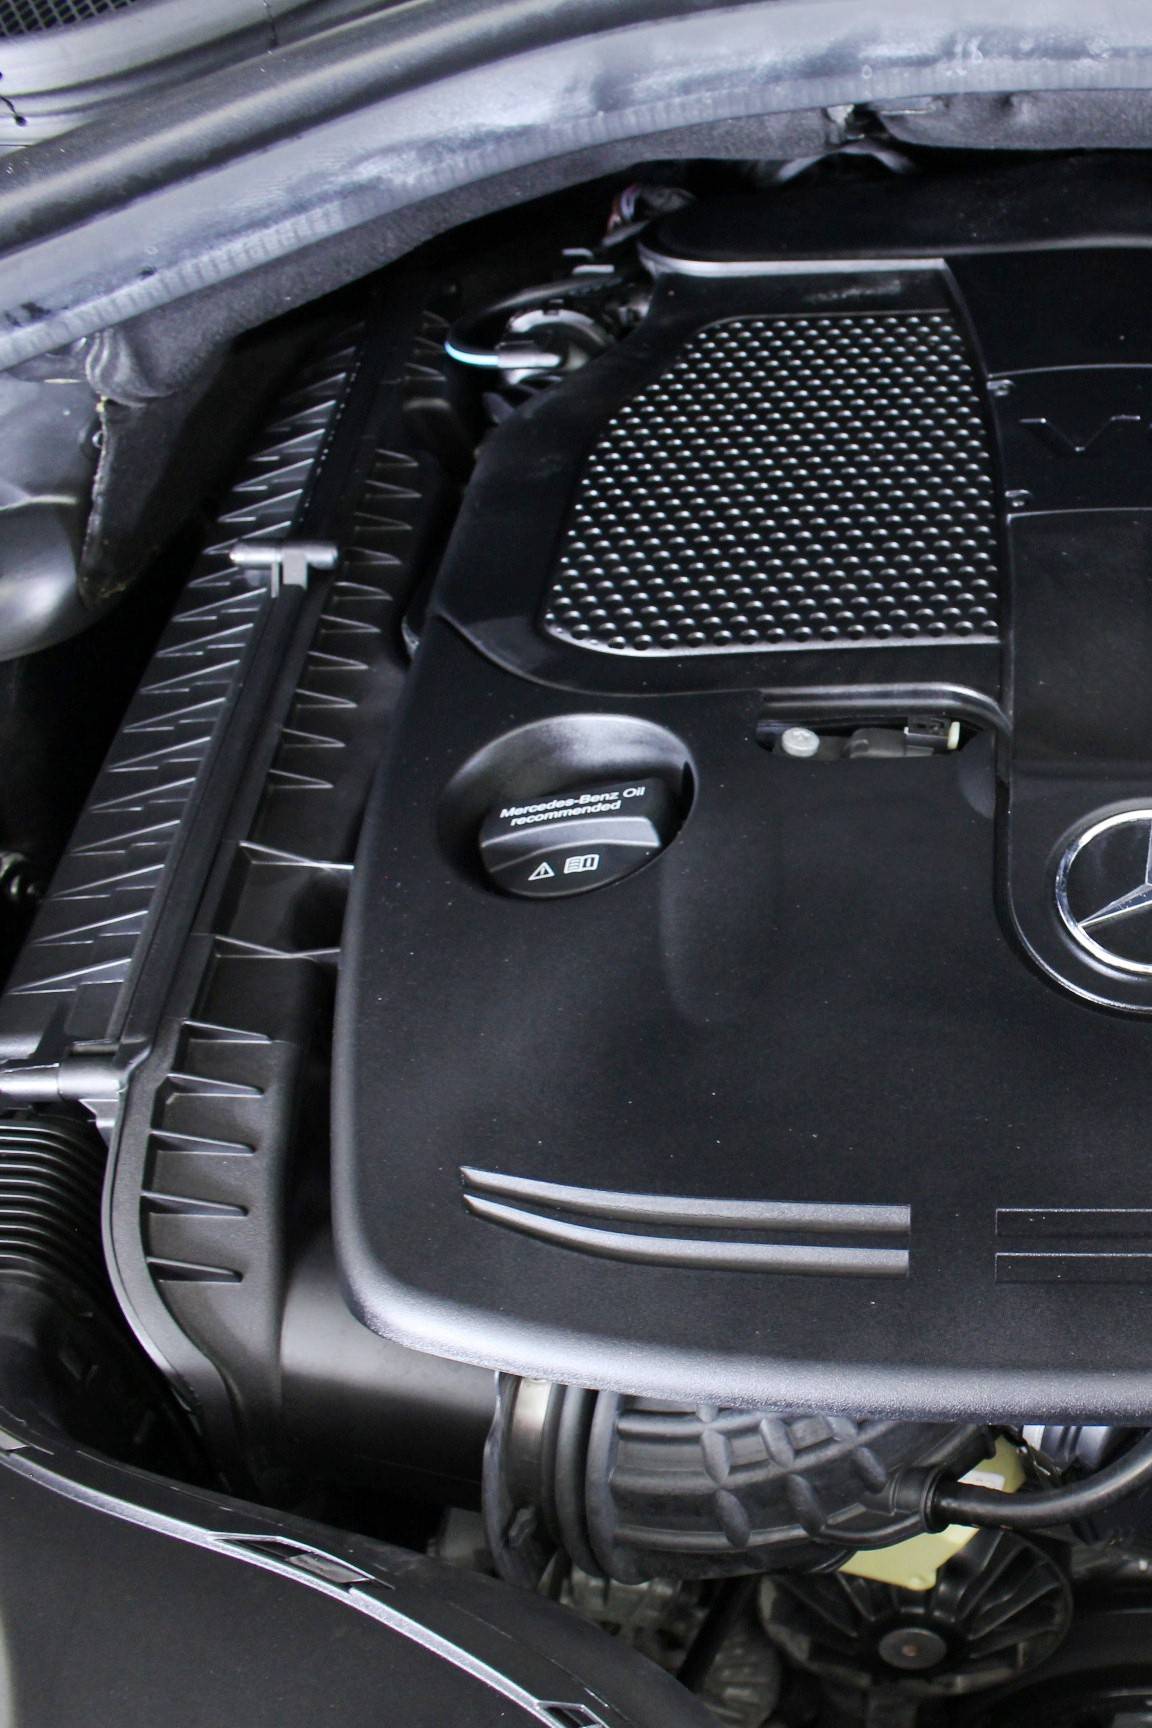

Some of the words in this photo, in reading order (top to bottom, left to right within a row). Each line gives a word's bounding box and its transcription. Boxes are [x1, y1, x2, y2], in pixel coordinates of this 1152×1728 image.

[499, 790, 620, 819] Mercedes-Benz
[622, 786, 646, 799] Oil
[509, 800, 622, 827] recommended
